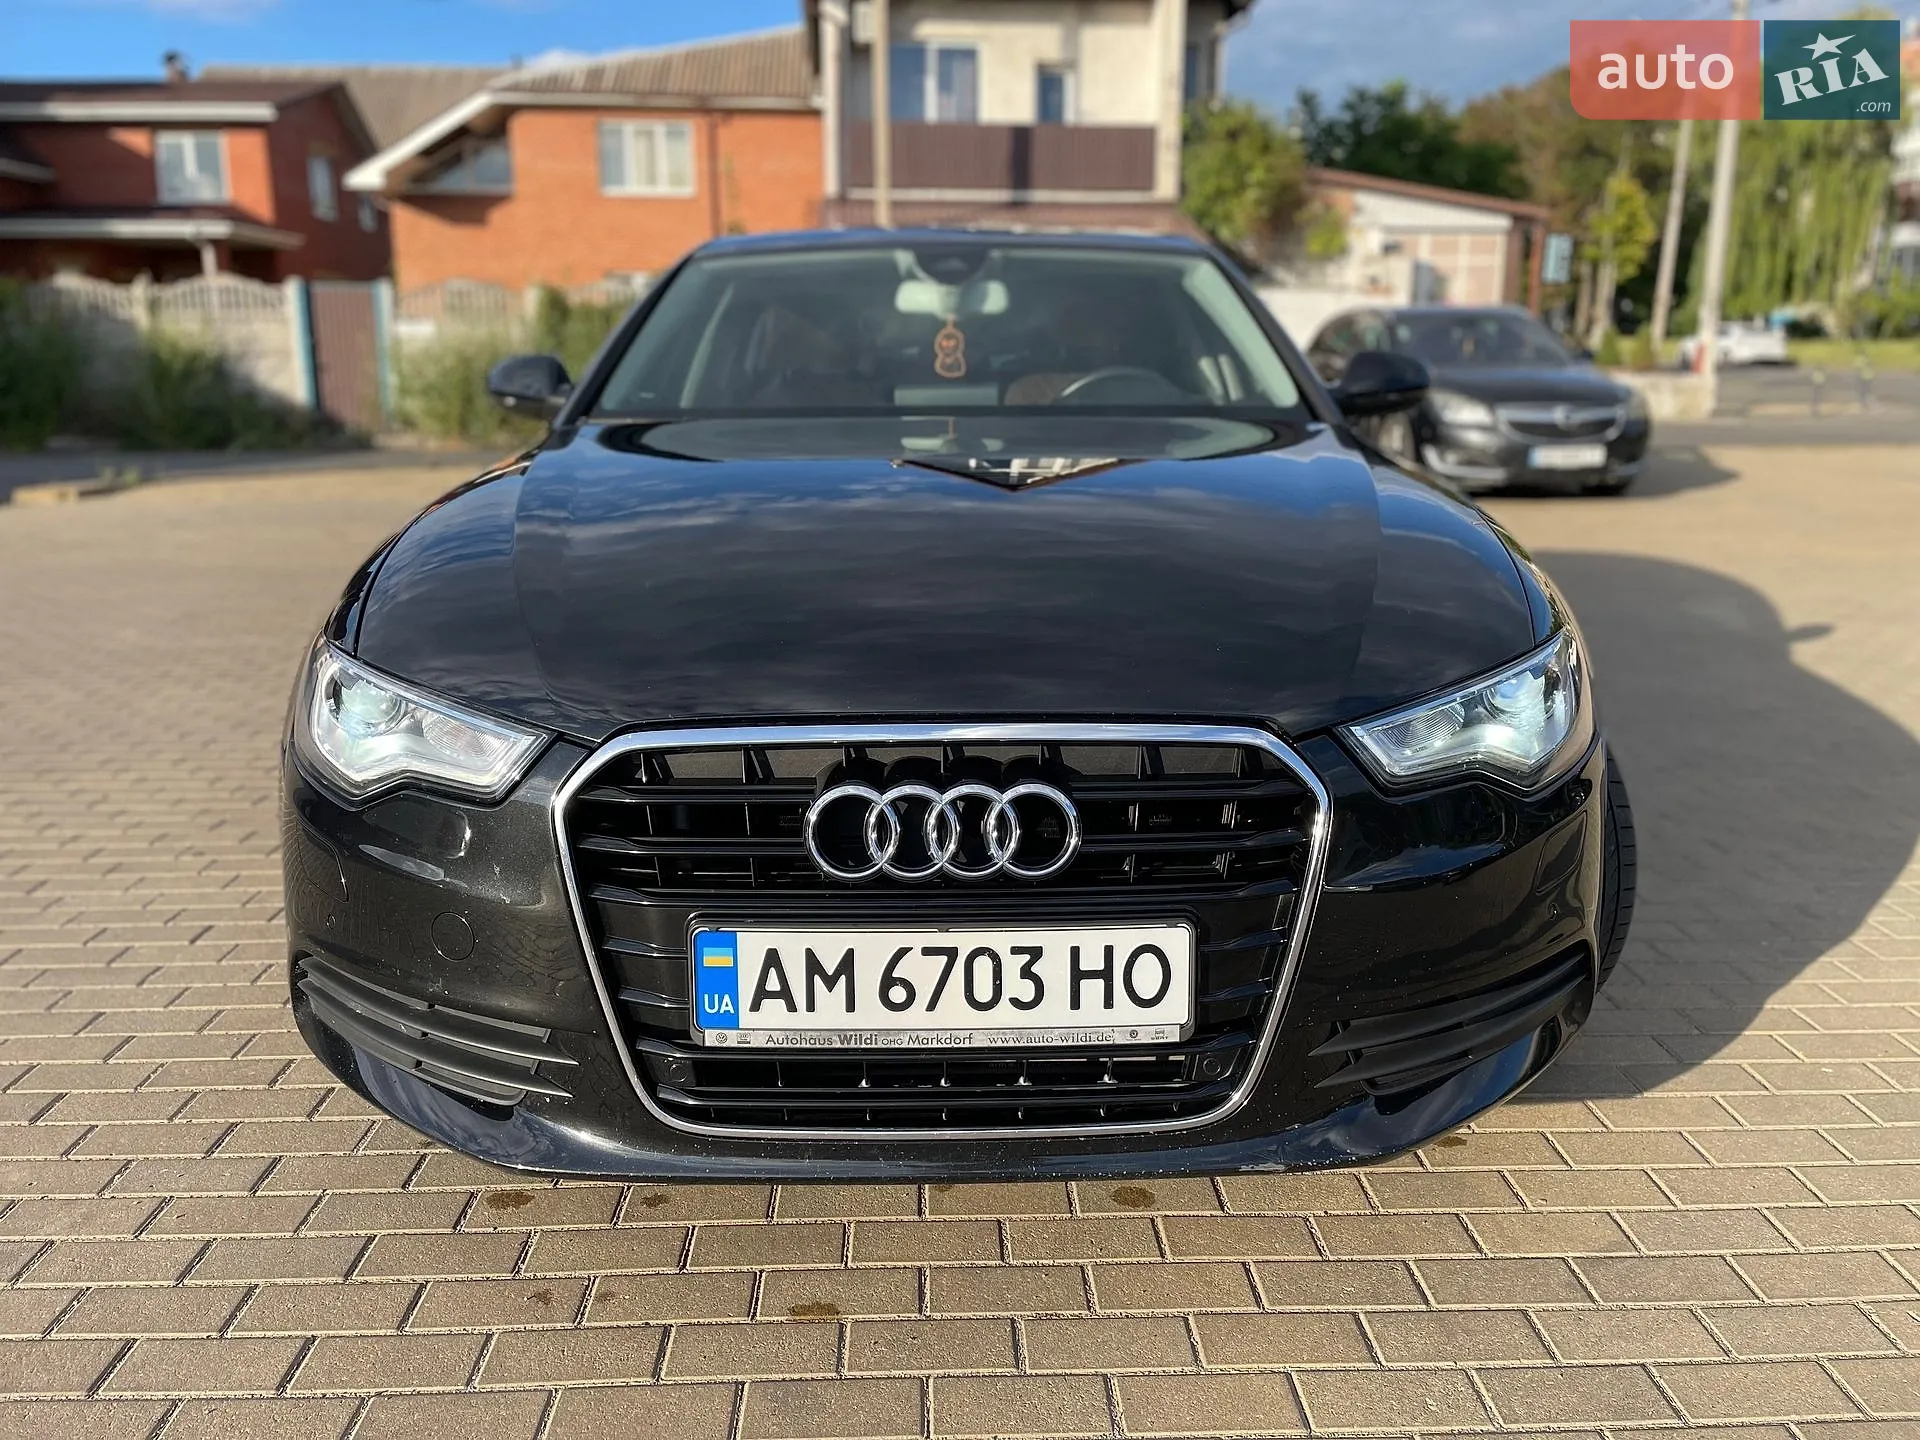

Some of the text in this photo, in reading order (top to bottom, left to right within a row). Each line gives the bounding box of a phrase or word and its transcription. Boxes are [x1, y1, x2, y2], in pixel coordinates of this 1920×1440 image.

[748, 943, 1172, 1014] AM 6703 HO
[703, 993, 735, 1014] UA
[765, 1033, 834, 1046] Autohaus
[837, 1033, 879, 1046] Wildi
[907, 1033, 974, 1046] Markdorf
[987, 1032, 1112, 1045] www.auto-wildi.de
